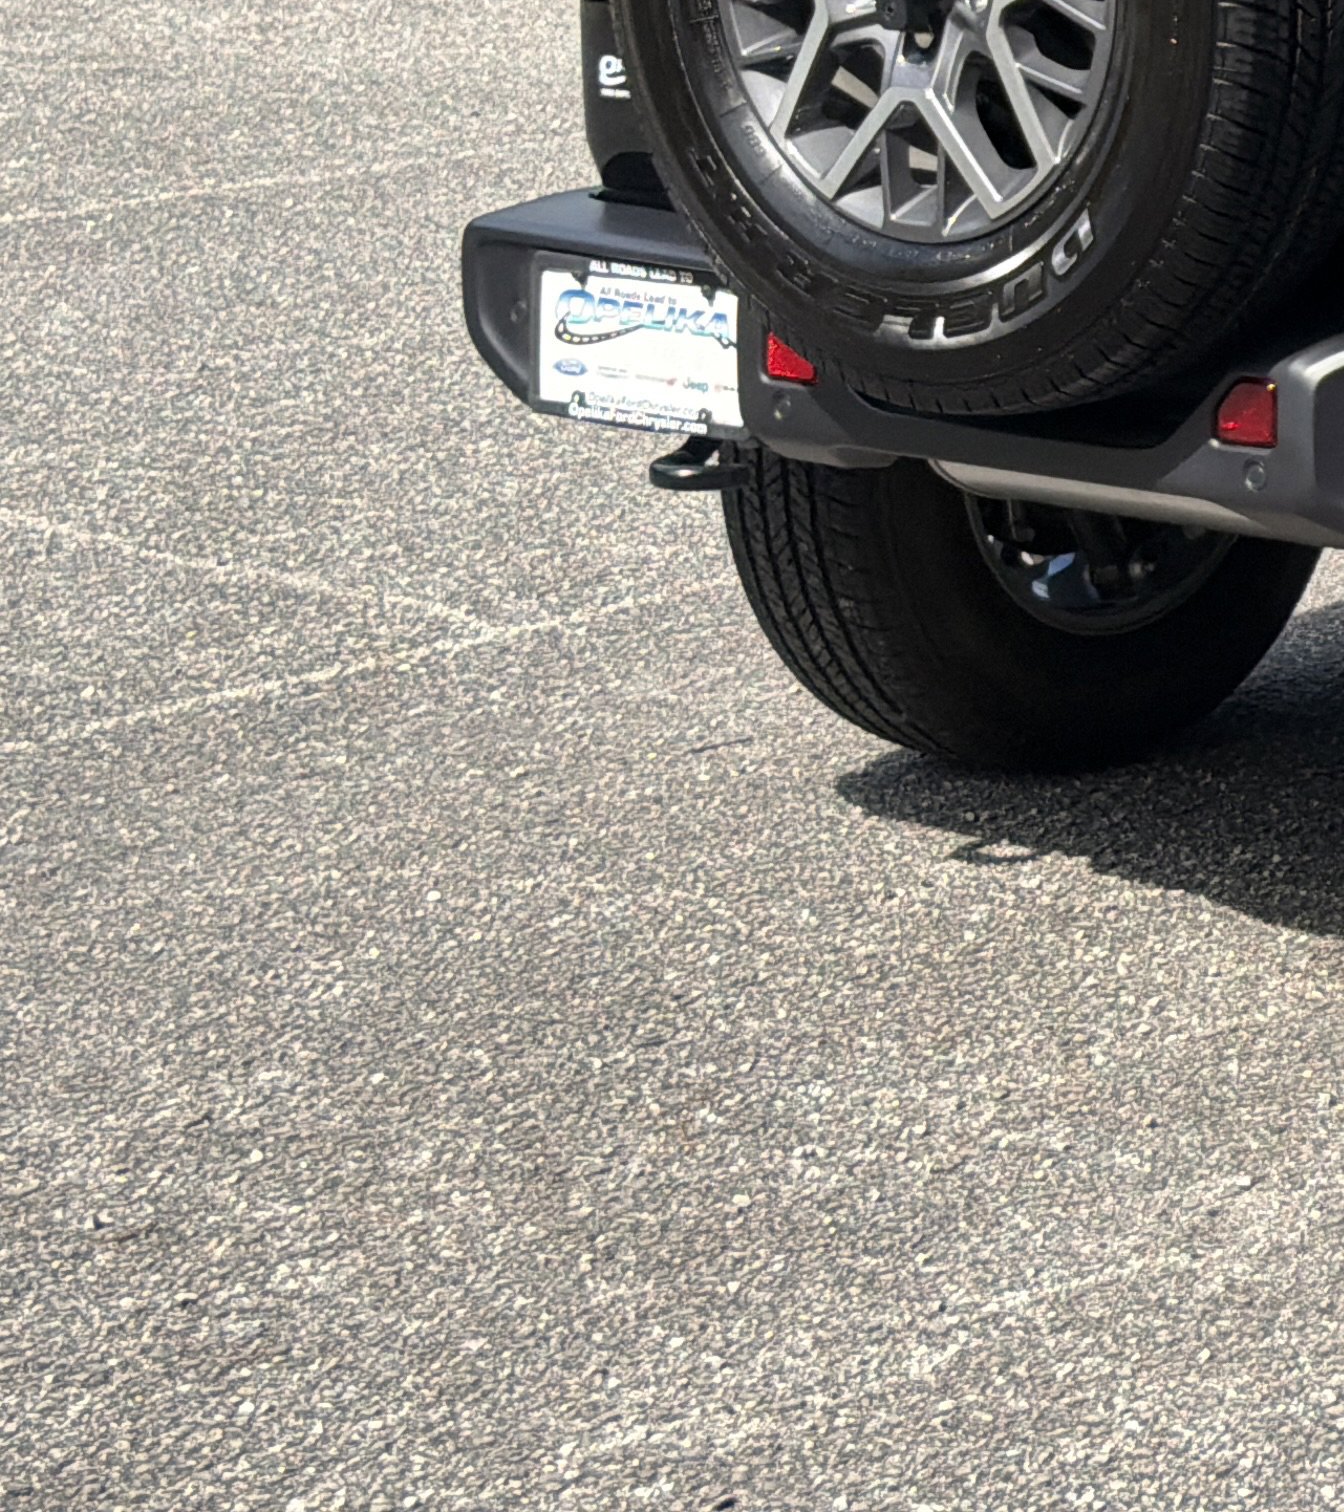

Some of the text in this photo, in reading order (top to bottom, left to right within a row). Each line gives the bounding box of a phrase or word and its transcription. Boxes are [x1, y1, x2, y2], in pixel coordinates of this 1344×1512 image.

[589, 260, 609, 274] ALL
[555, 288, 731, 340] OPELIKA
[682, 377, 709, 393] Jeep
